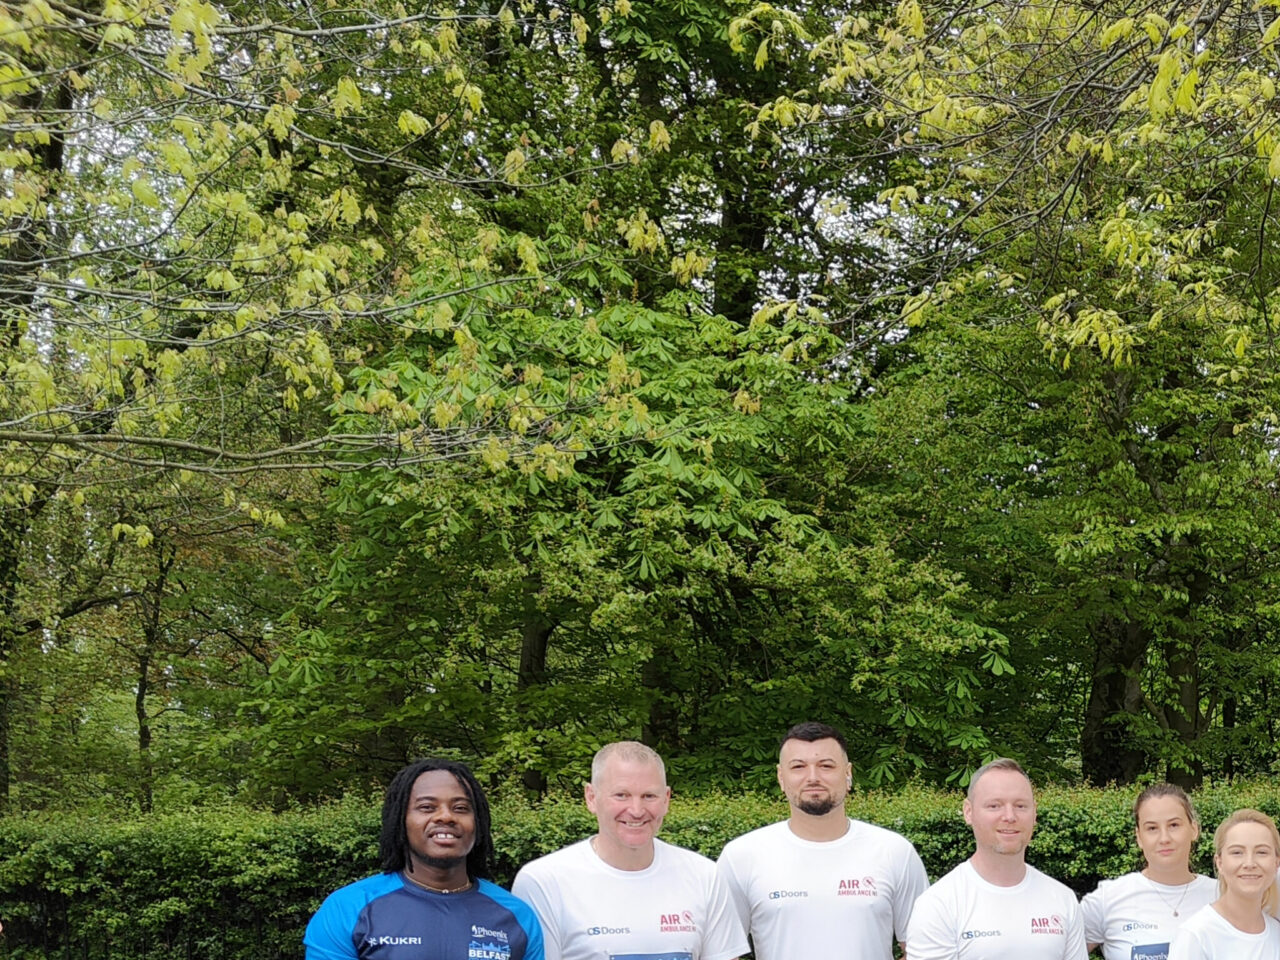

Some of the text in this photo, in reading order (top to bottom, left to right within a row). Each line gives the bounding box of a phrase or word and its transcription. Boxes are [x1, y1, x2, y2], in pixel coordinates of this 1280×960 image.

[839, 879, 860, 889] AIR
[660, 914, 681, 925] AIR
[1032, 918, 1050, 928] AIR
[478, 926, 508, 940] Phoenix
[380, 936, 422, 945] KUKRI
